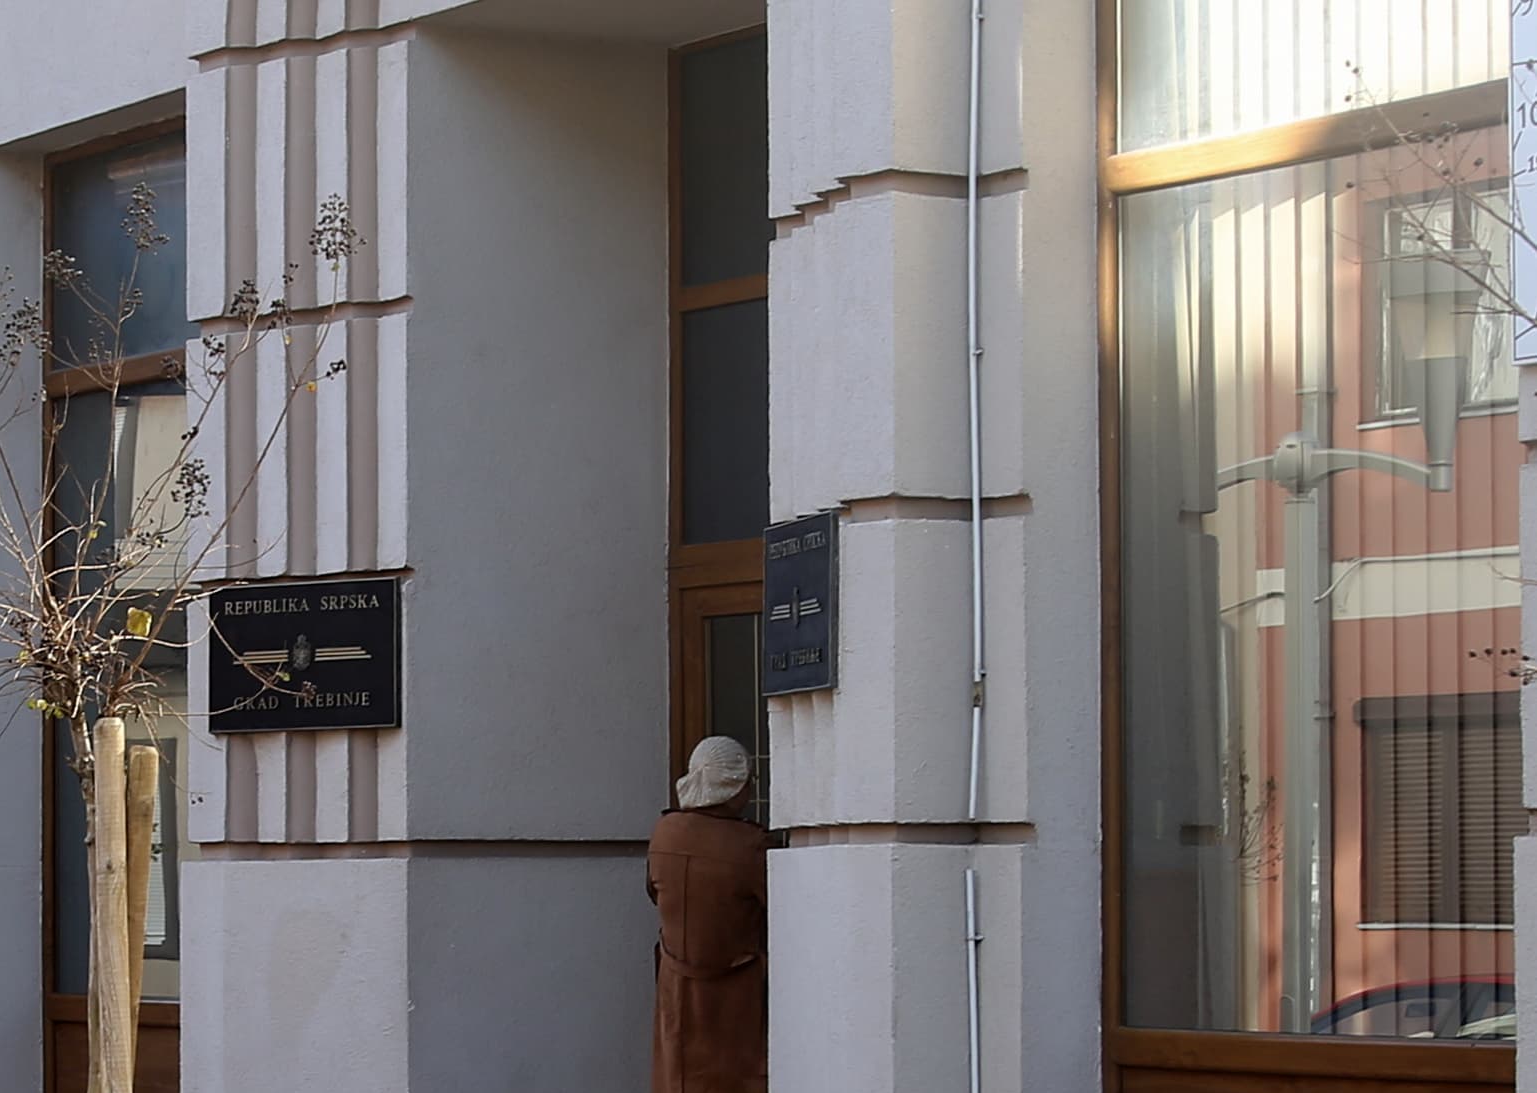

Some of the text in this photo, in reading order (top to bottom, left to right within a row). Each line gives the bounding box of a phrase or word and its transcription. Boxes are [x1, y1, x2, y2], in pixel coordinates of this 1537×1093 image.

[224, 594, 380, 615] REPUBLIKA SRPSKA
[233, 695, 279, 711] GRAD
